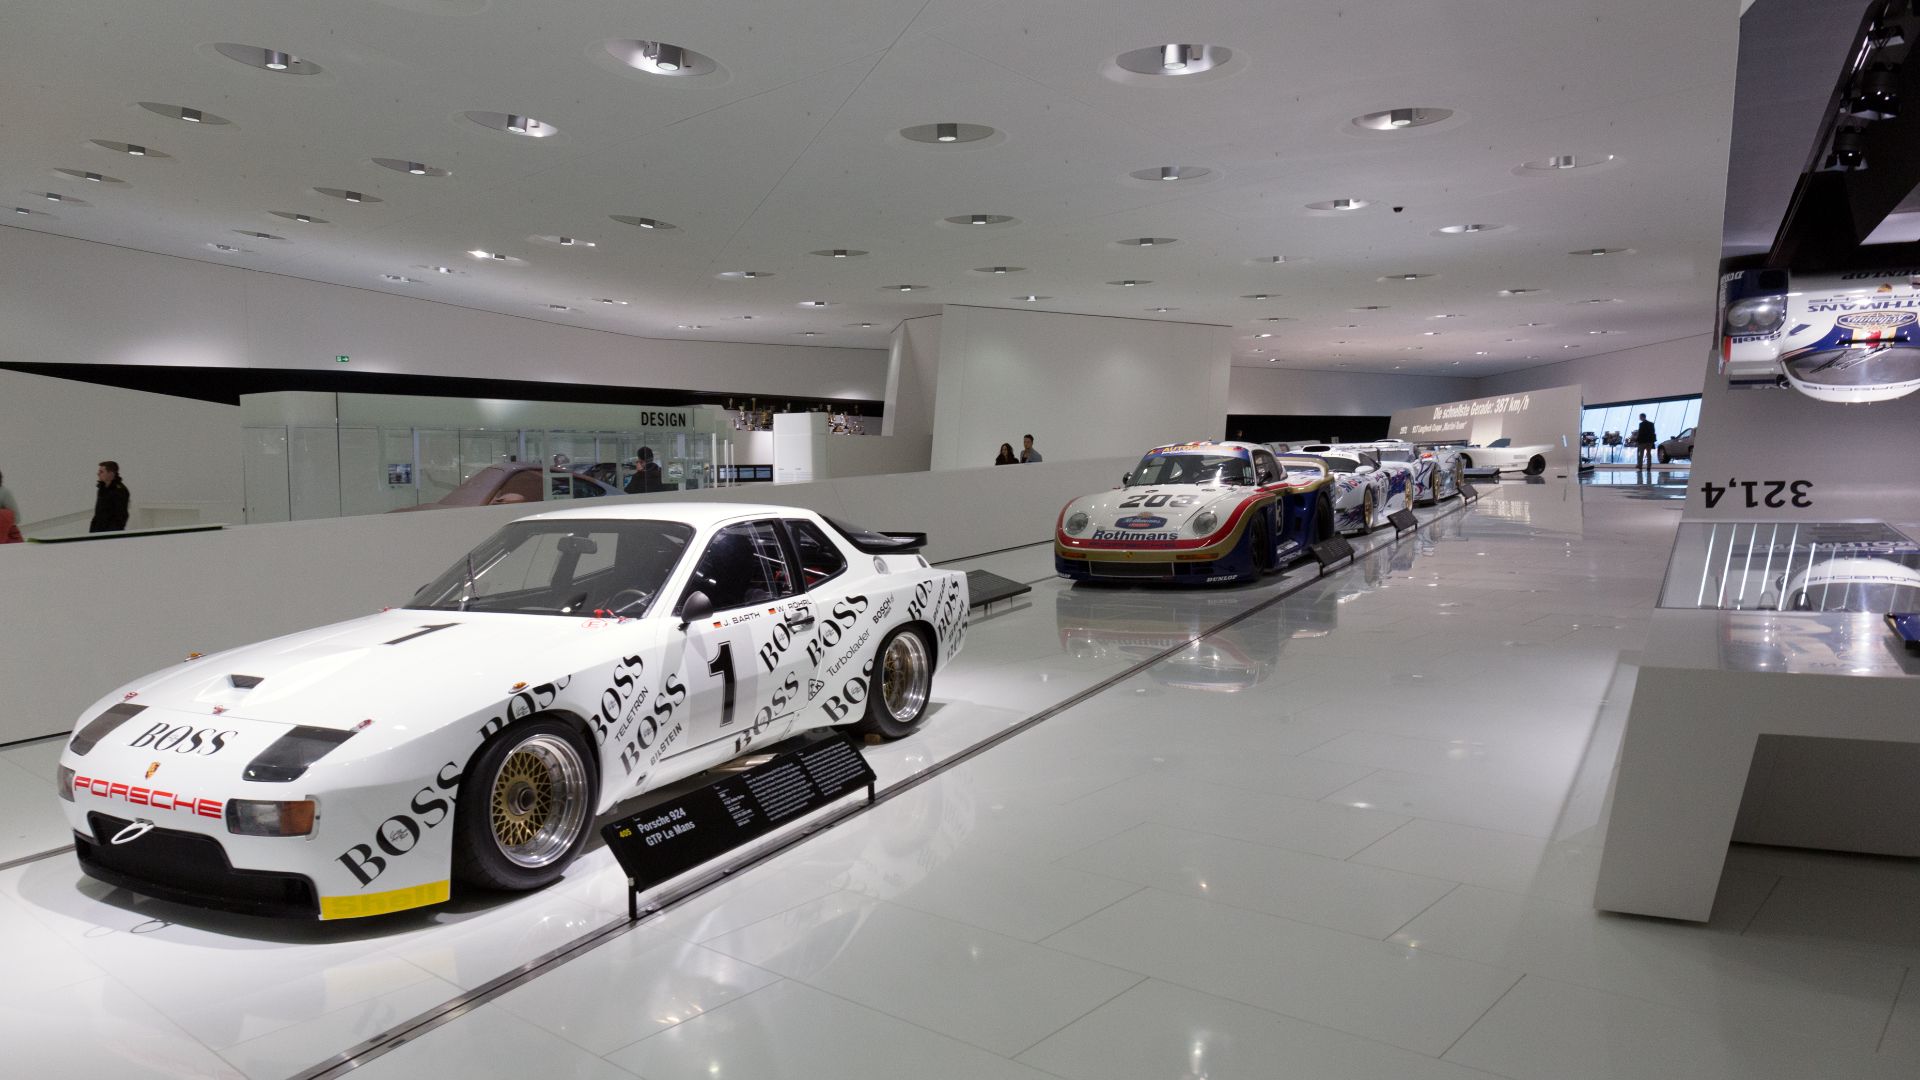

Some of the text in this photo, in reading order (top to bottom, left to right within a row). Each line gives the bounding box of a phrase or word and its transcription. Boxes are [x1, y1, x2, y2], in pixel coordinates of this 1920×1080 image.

[1808, 300, 1920, 313] THMANS
[641, 411, 687, 428] DESIGN
[1433, 407, 1442, 420] Die
[1470, 400, 1494, 416] Gerade:
[1119, 494, 1199, 509] 203
[1701, 478, 1814, 509] 321,4
[1092, 529, 1179, 541] Rothmans
[1206, 574, 1238, 583] DUNLOP
[732, 612, 761, 625] BARTH
[872, 597, 891, 624] BOSCH
[938, 574, 960, 642] BOSS
[382, 622, 462, 645] 1
[806, 595, 868, 668] BOSS
[826, 628, 871, 677] Turbolader
[708, 640, 737, 728] 1
[588, 655, 644, 747] BOSS
[614, 686, 649, 742] TELETRON
[734, 671, 799, 754] BOSS
[128, 722, 239, 755] BOSS
[619, 673, 687, 776] BOSS
[650, 722, 683, 767] BILSTEIN
[74, 775, 225, 819] PORSCHE
[335, 761, 463, 889] BOSS
[637, 807, 687, 834] Porsche 924
[645, 821, 696, 847] GTP Le Mans
